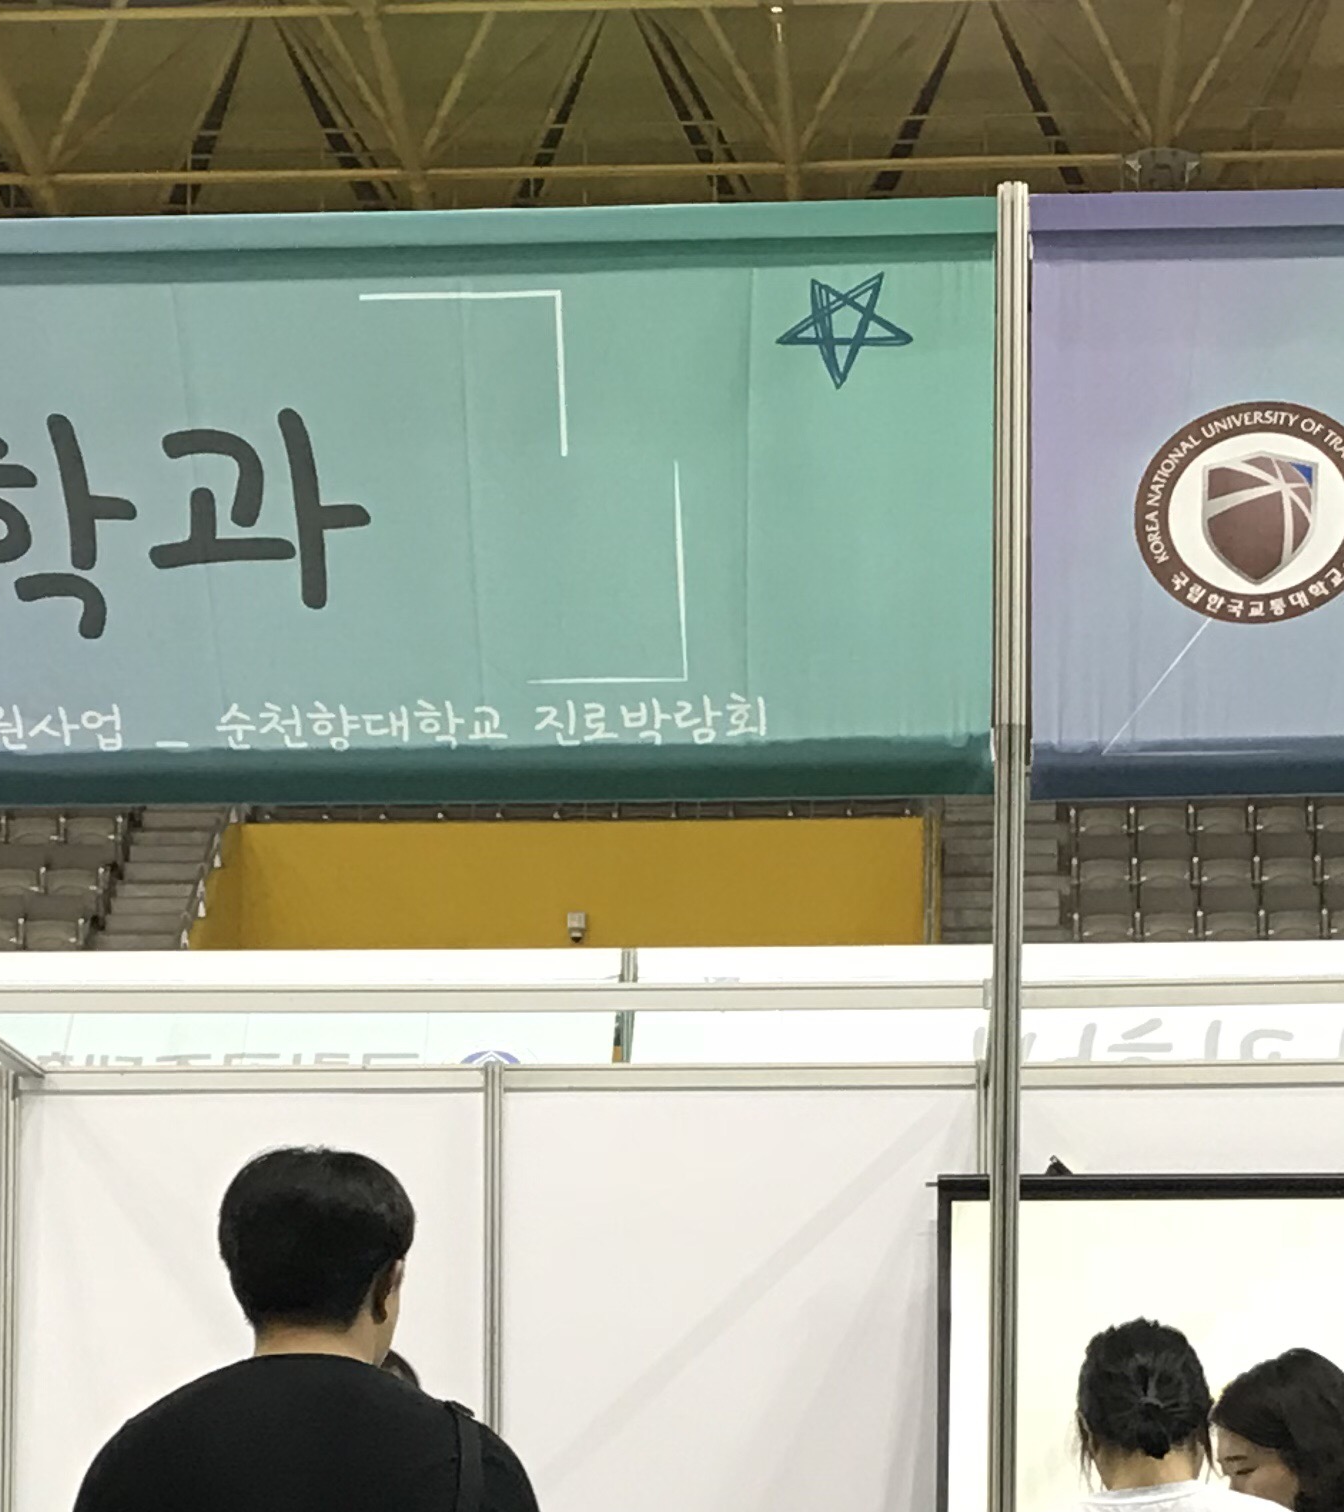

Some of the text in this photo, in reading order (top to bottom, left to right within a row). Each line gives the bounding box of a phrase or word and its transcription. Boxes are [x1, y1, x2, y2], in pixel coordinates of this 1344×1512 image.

[1201, 410, 1300, 439] UNIVERSITY
[1300, 418, 1325, 437] OF
[1146, 434, 1202, 507] NATIONAL
[1145, 511, 1170, 564] KOREA
[214, 698, 509, 751] 순천향대학교
[533, 691, 769, 747] 진로박람회
